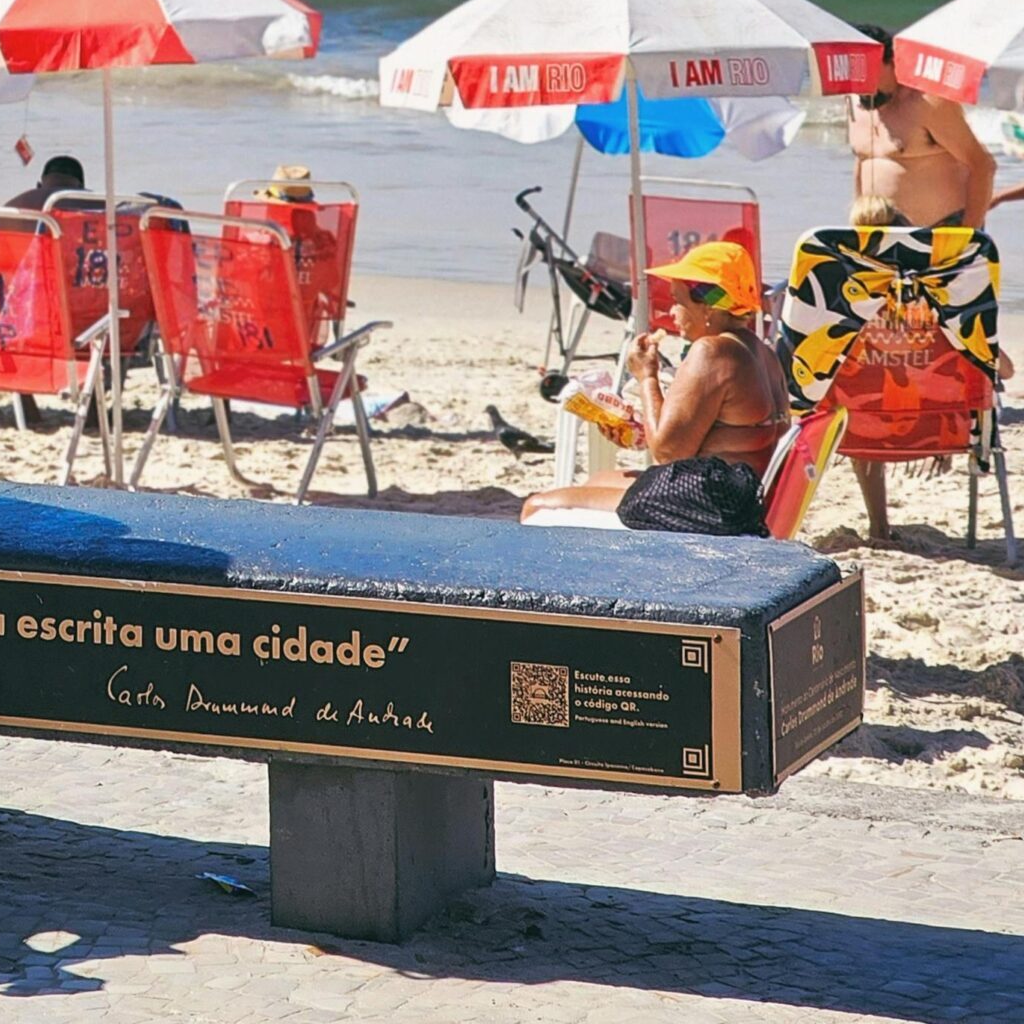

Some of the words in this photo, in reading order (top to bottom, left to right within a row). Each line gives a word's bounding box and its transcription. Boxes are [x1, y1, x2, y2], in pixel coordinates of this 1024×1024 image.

[490, 65, 498, 93] I
[503, 64, 539, 93] AM
[546, 63, 586, 93] RIO
[669, 61, 679, 88] I
[685, 59, 723, 87] AM
[727, 57, 769, 86] RIO
[833, 54, 850, 82] AM
[858, 348, 933, 367] AMSTEL
[17, 609, 143, 647] escrita
[155, 626, 241, 656] uma
[574, 670, 606, 682] Escute
[607, 675, 631, 684] essa
[107, 665, 166, 709] Carlos
[185, 683, 297, 718] Drummond
[316, 702, 339, 722] de
[347, 698, 435, 734] Andrade
[574, 683, 613, 696] história
[614, 689, 669, 701] acessando
[574, 699, 582, 707] o
[583, 698, 618, 712] código
[620, 702, 640, 712] QR.
